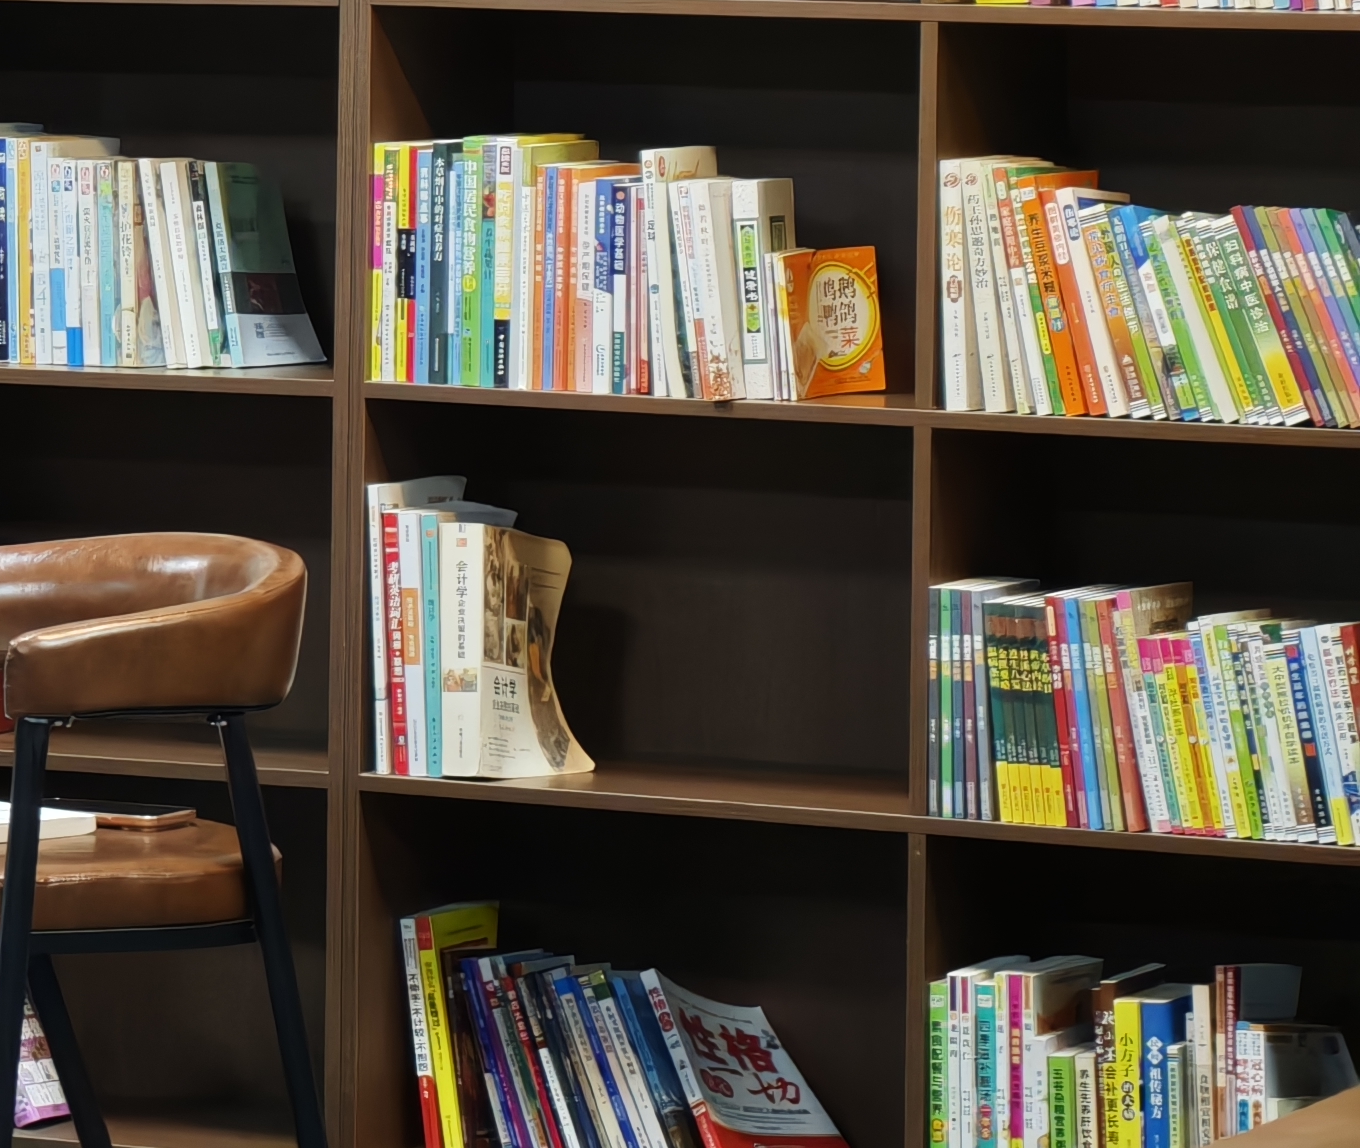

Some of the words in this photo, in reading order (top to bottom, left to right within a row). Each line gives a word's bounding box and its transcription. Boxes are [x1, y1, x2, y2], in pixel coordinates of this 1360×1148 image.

[944, 205, 962, 272] 伤寒论
[1223, 239, 1270, 335] 妇科病中医诊治
[456, 560, 468, 598] 会计学
[493, 676, 518, 699] 会计学
